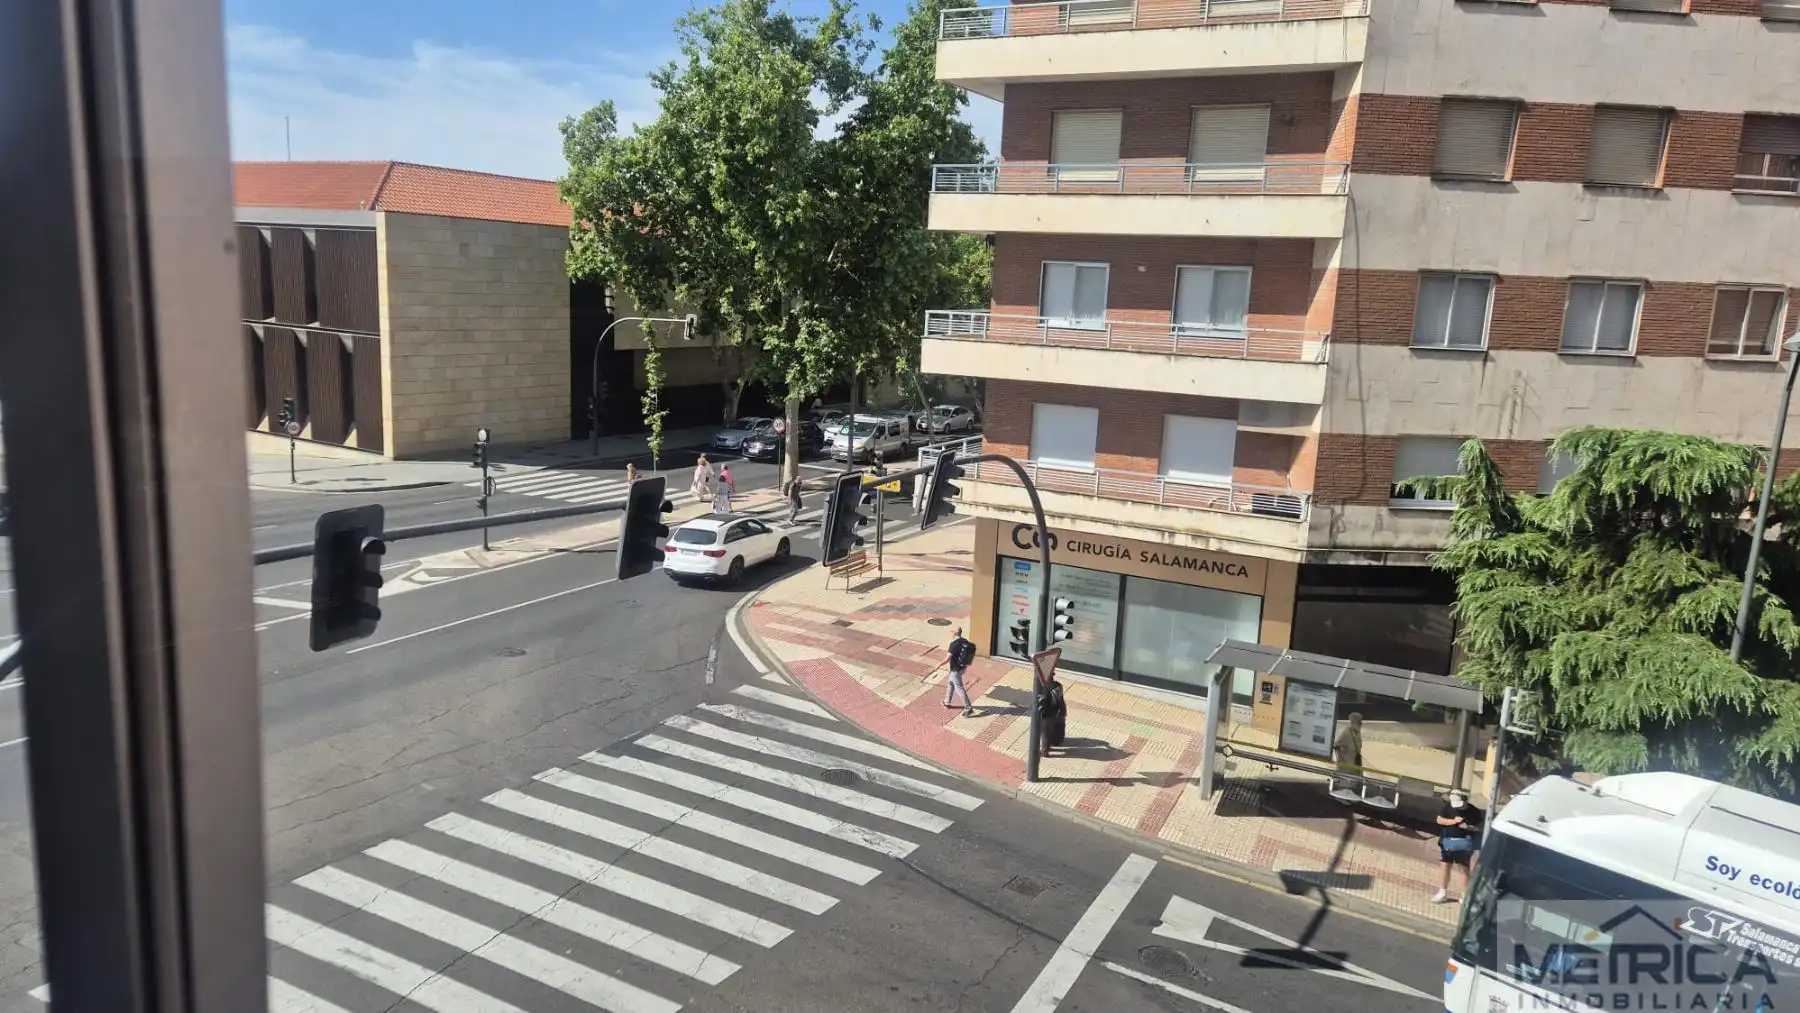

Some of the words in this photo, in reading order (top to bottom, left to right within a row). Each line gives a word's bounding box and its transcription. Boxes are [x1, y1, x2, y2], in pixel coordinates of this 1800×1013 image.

[1066, 540, 1132, 560] CIRUGÍA
[1140, 550, 1249, 578] SALAMANCA
[1705, 855, 1742, 881] Soy
[1726, 929, 1795, 965] Transportes
[1740, 922, 1800, 955] Salamanca
